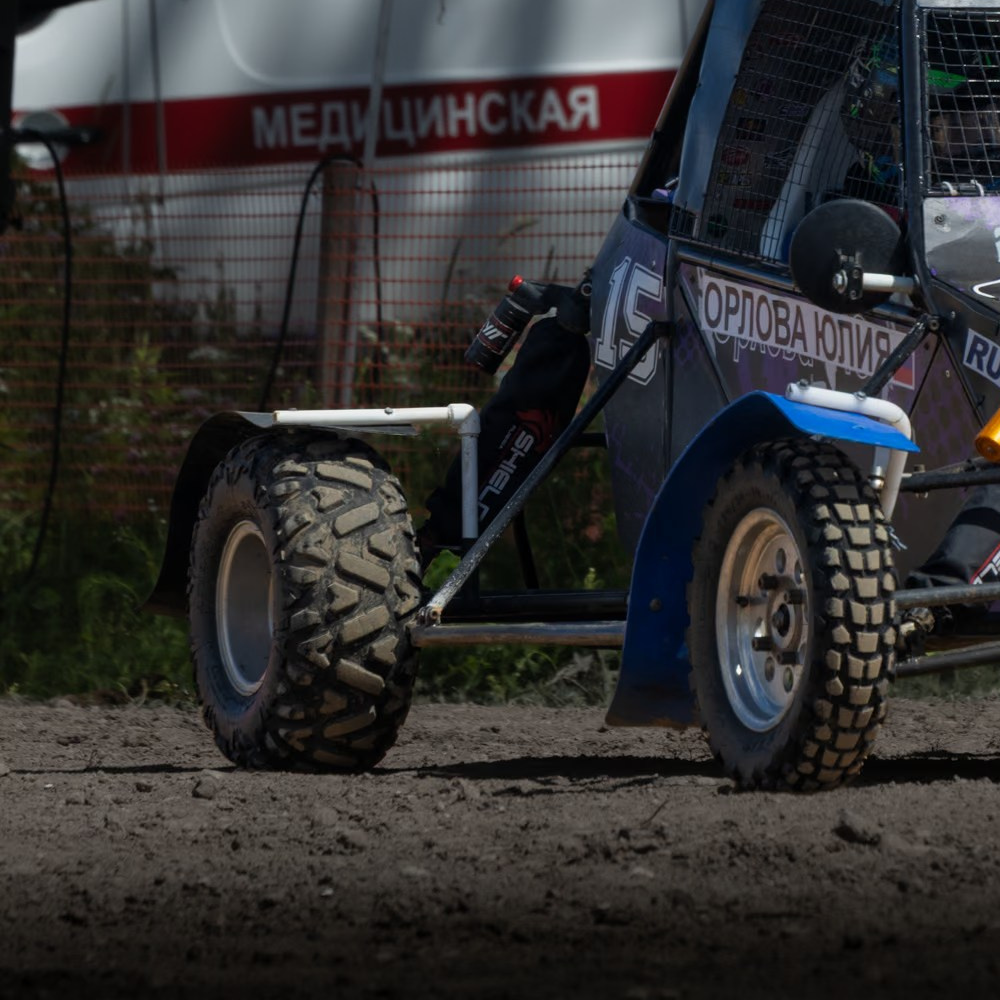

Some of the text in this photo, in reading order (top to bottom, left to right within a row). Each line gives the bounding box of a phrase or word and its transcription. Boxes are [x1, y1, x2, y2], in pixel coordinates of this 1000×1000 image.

[252, 85, 601, 150] МЕДИЦИНСКАЯ
[595, 256, 663, 386] 15
[704, 281, 808, 352] ОРЛОВА
[814, 311, 891, 373] ЮЛИЯ
